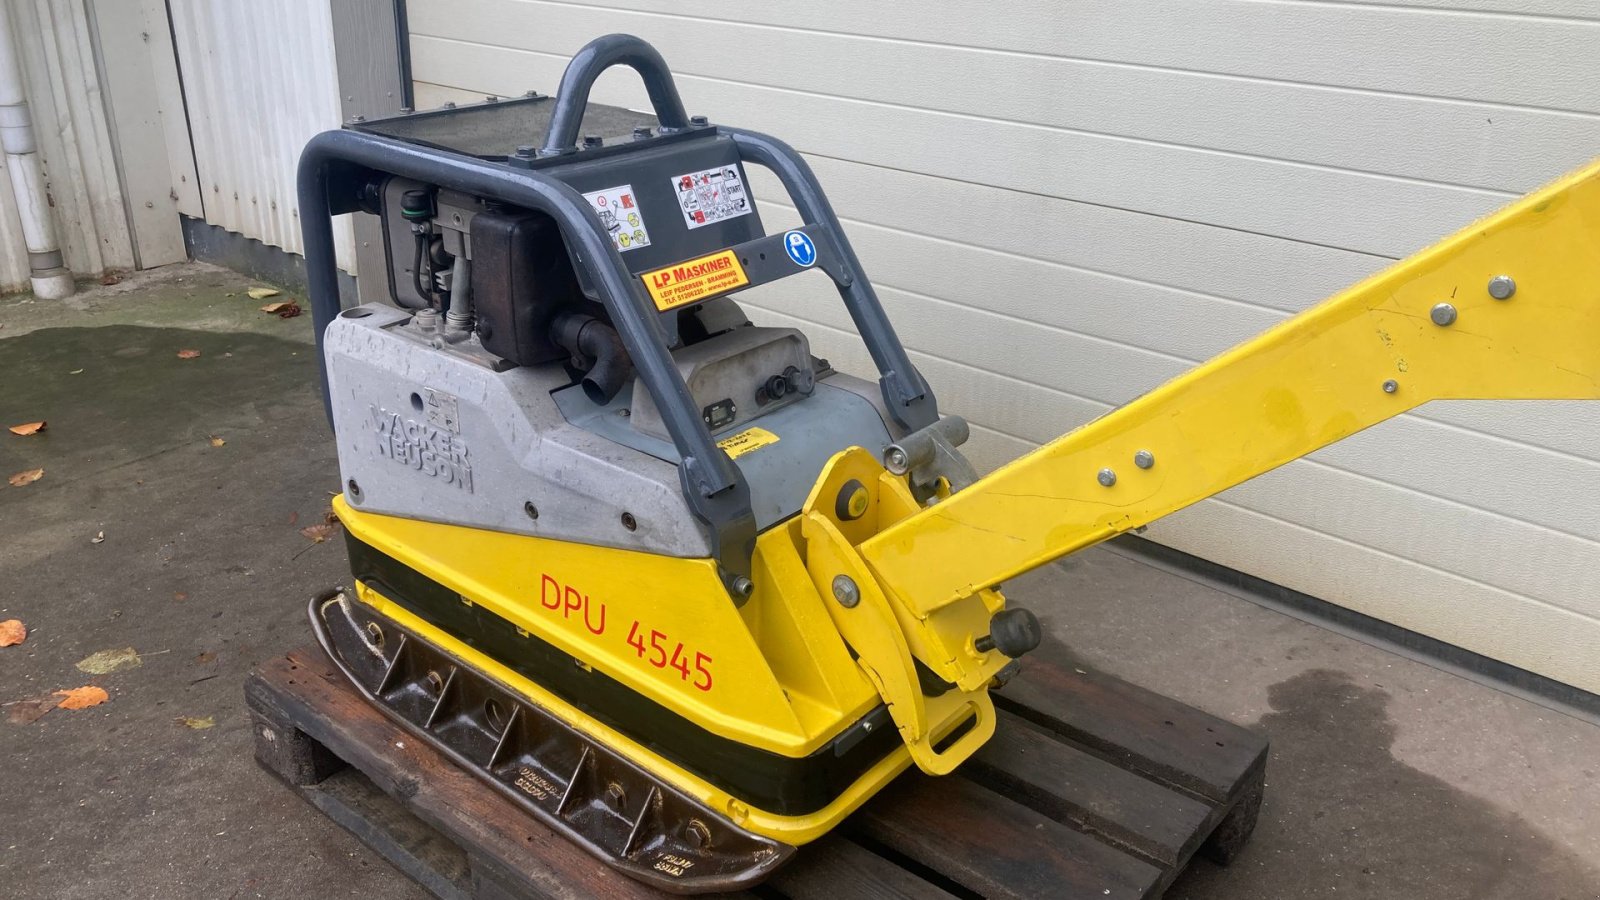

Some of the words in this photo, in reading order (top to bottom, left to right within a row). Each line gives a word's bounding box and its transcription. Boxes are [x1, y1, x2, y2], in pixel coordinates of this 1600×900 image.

[726, 185, 742, 195] START
[653, 272, 671, 289] LP
[672, 256, 731, 283] MASKINER
[660, 289, 673, 298] LEIF
[675, 281, 704, 296] PEDERSEN
[707, 270, 737, 283] BRAMMING
[369, 403, 472, 469] WACKER
[377, 432, 475, 494] NEUSON
[541, 573, 606, 635] DPU
[626, 620, 713, 692] 4545
